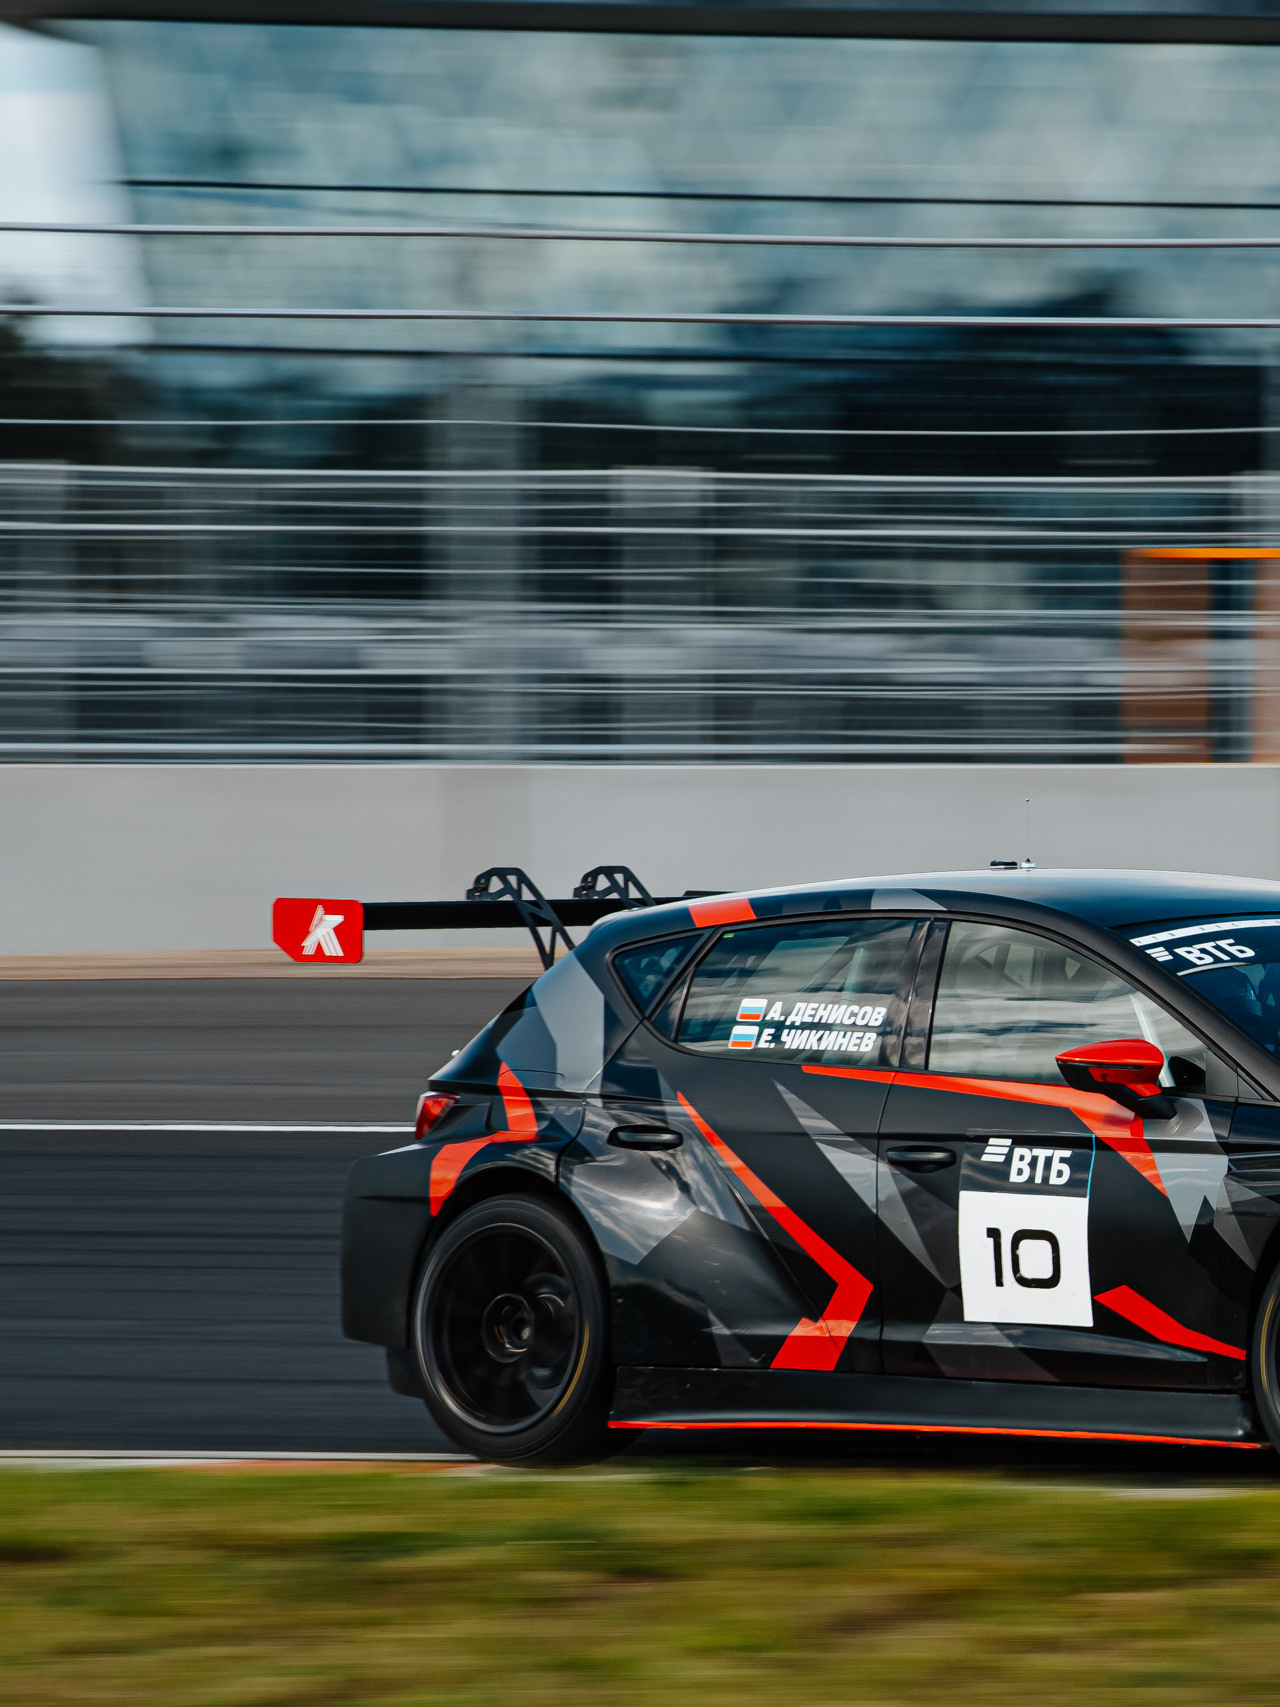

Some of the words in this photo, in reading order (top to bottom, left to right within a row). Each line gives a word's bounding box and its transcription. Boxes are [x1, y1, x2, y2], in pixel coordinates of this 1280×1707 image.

[1172, 938, 1256, 965] ВТБ
[764, 1001, 786, 1022] А.
[785, 1002, 887, 1027] ДЕНИСОВ
[757, 1028, 776, 1049] Е.
[780, 1029, 878, 1053] ЧИКИНЕВ
[1009, 1147, 1073, 1186] ВТБ
[986, 1227, 1062, 1290] 10
